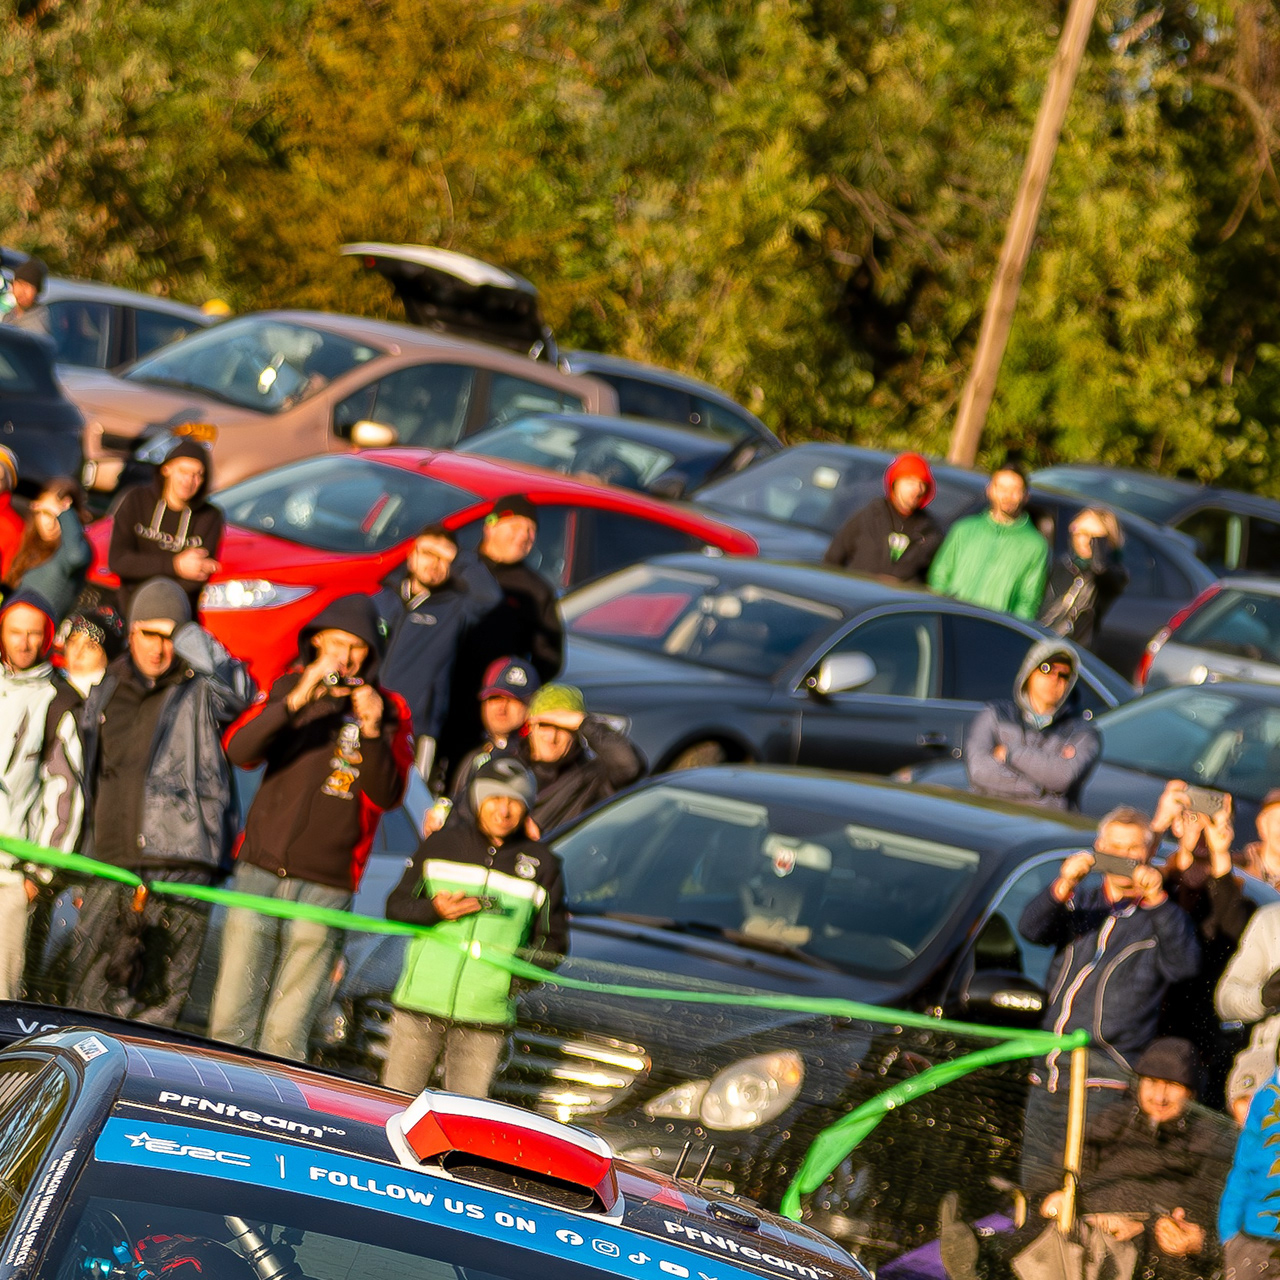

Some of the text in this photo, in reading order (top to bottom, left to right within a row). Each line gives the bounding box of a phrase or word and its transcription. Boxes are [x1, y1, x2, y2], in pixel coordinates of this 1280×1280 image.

[158, 1091, 324, 1138] PFNteam
[309, 1165, 538, 1234] FOLLOW US ON
[663, 1220, 819, 1280] PFNteam
